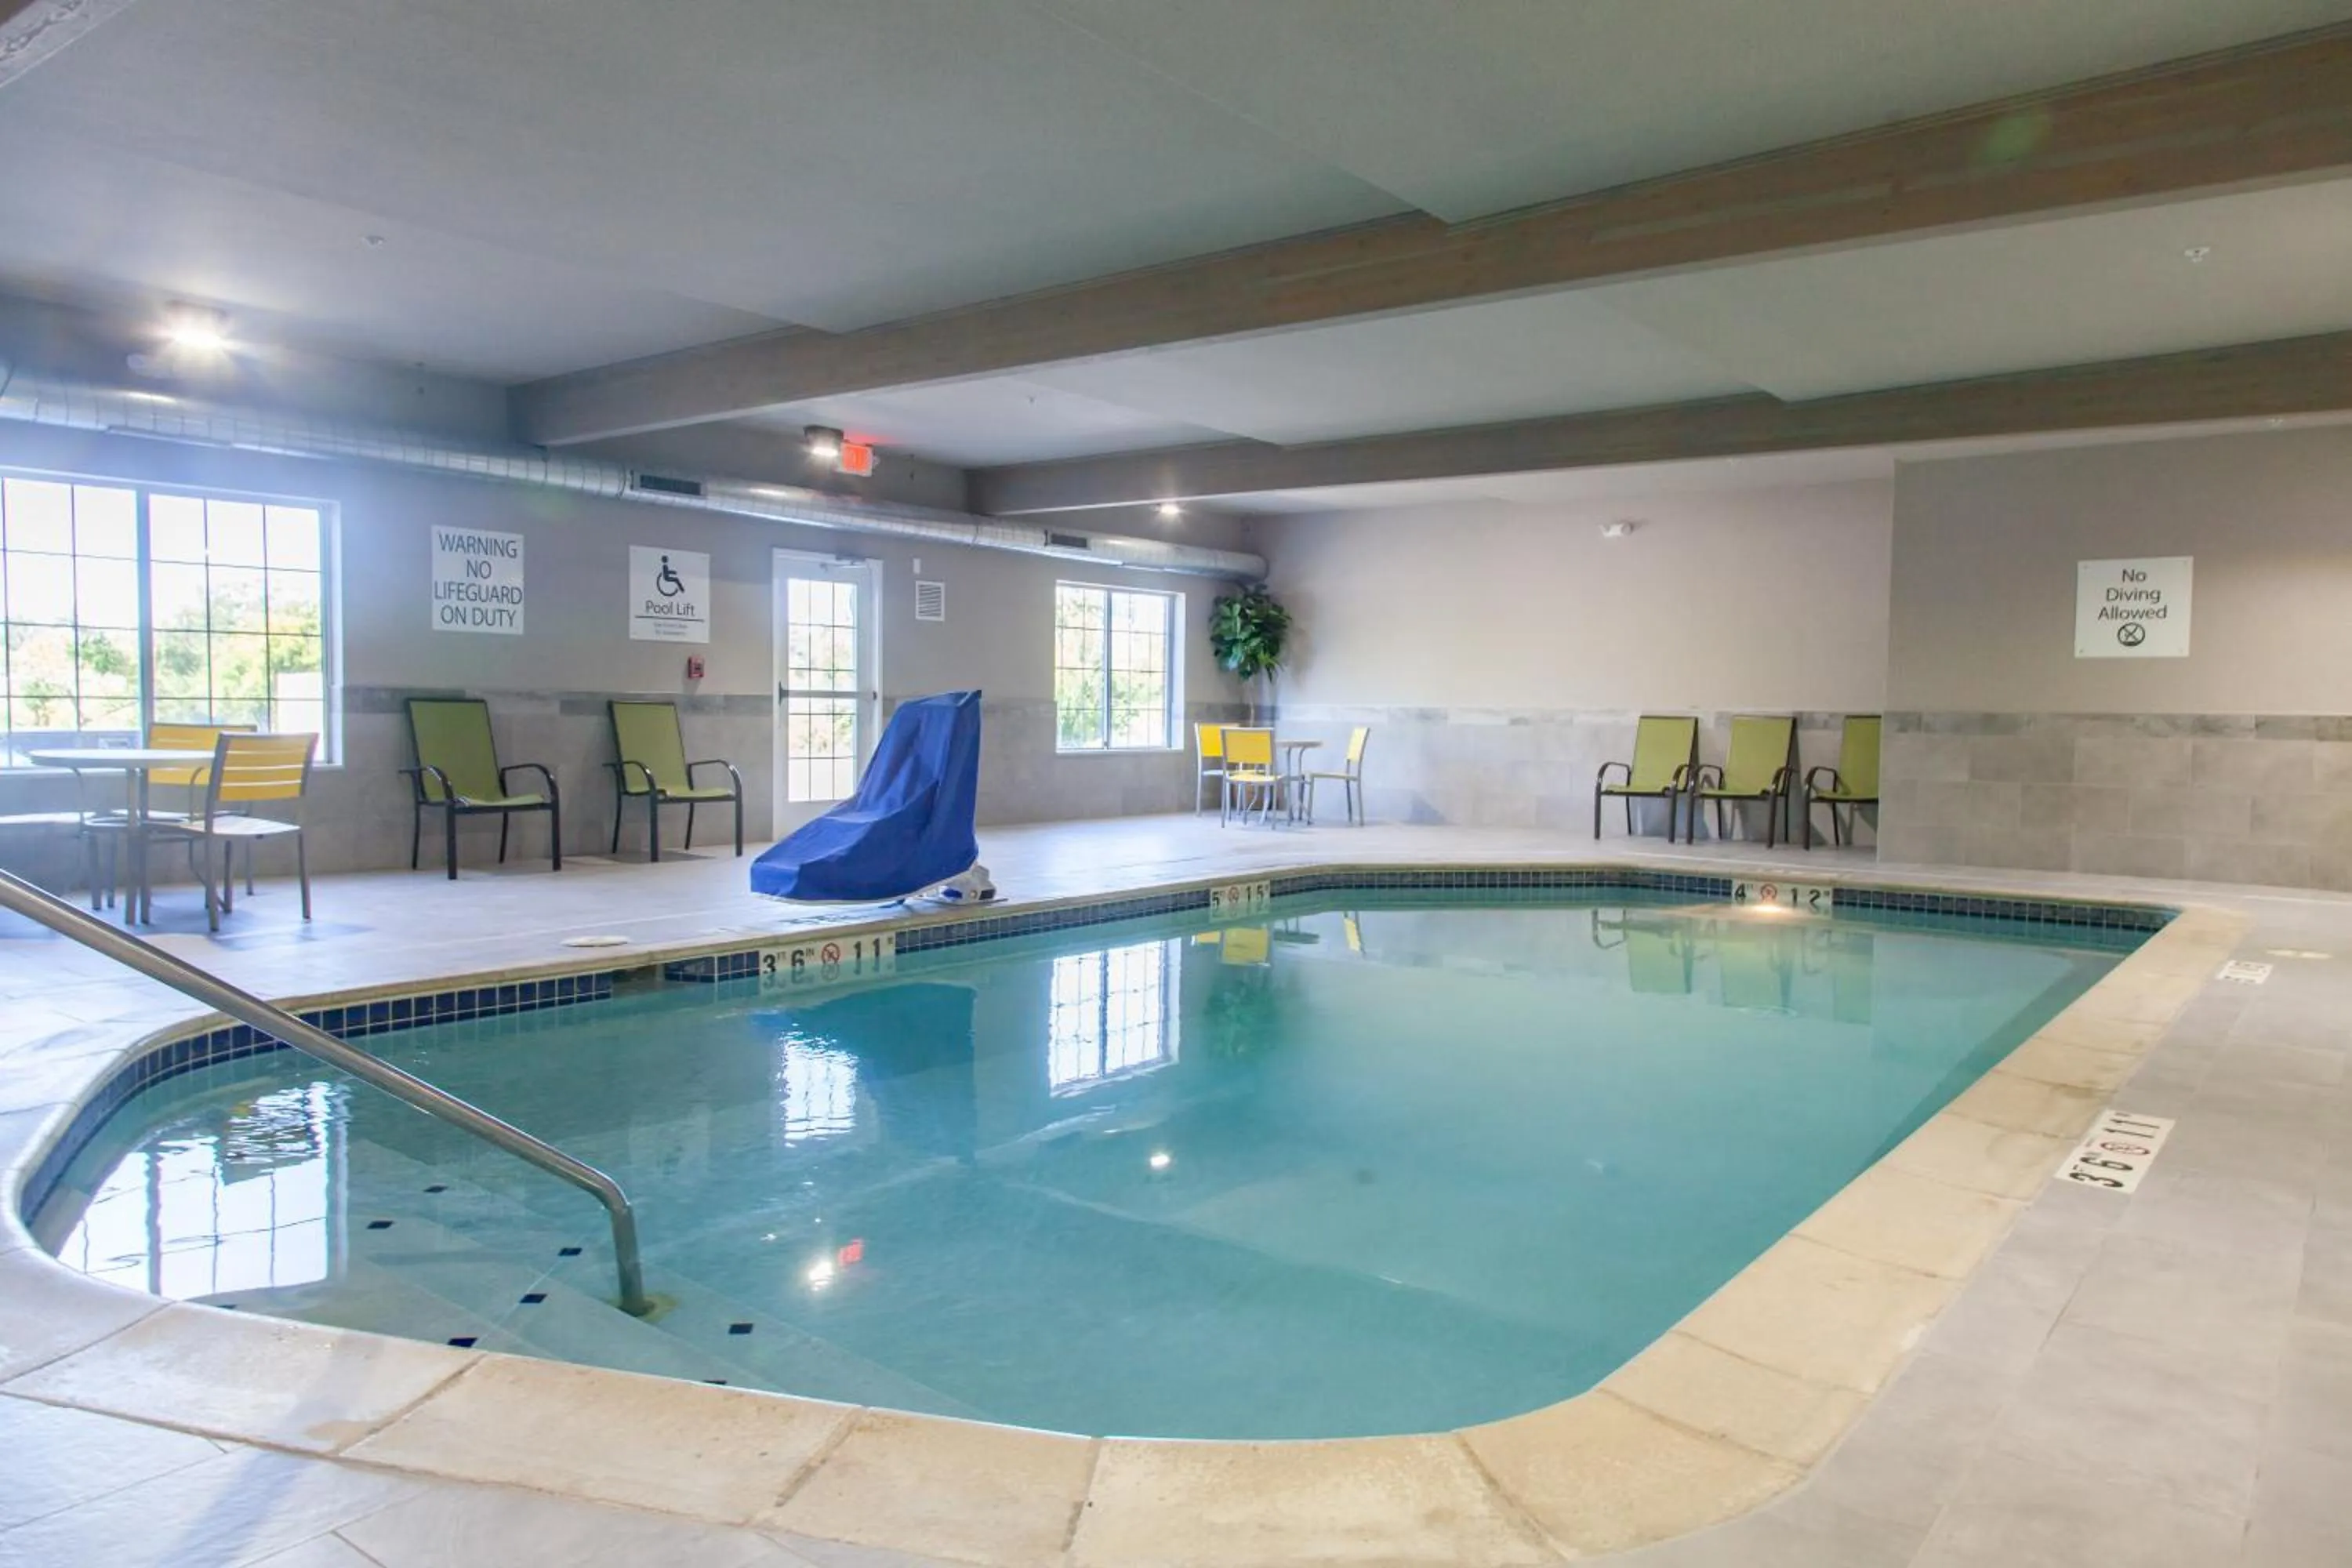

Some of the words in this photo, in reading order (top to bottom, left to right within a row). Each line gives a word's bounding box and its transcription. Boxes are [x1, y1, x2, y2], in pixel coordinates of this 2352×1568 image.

[437, 532, 517, 559] WARNING
[466, 559, 492, 579] NO
[2122, 568, 2147, 583] No
[434, 580, 523, 604] LIFEGUARD
[2106, 587, 2161, 604] Diving
[441, 604, 466, 625] ON
[472, 607, 517, 627] DUTY
[645, 600, 673, 615] Pool
[677, 602, 695, 616] Lift
[2097, 604, 2168, 620] Allowed
